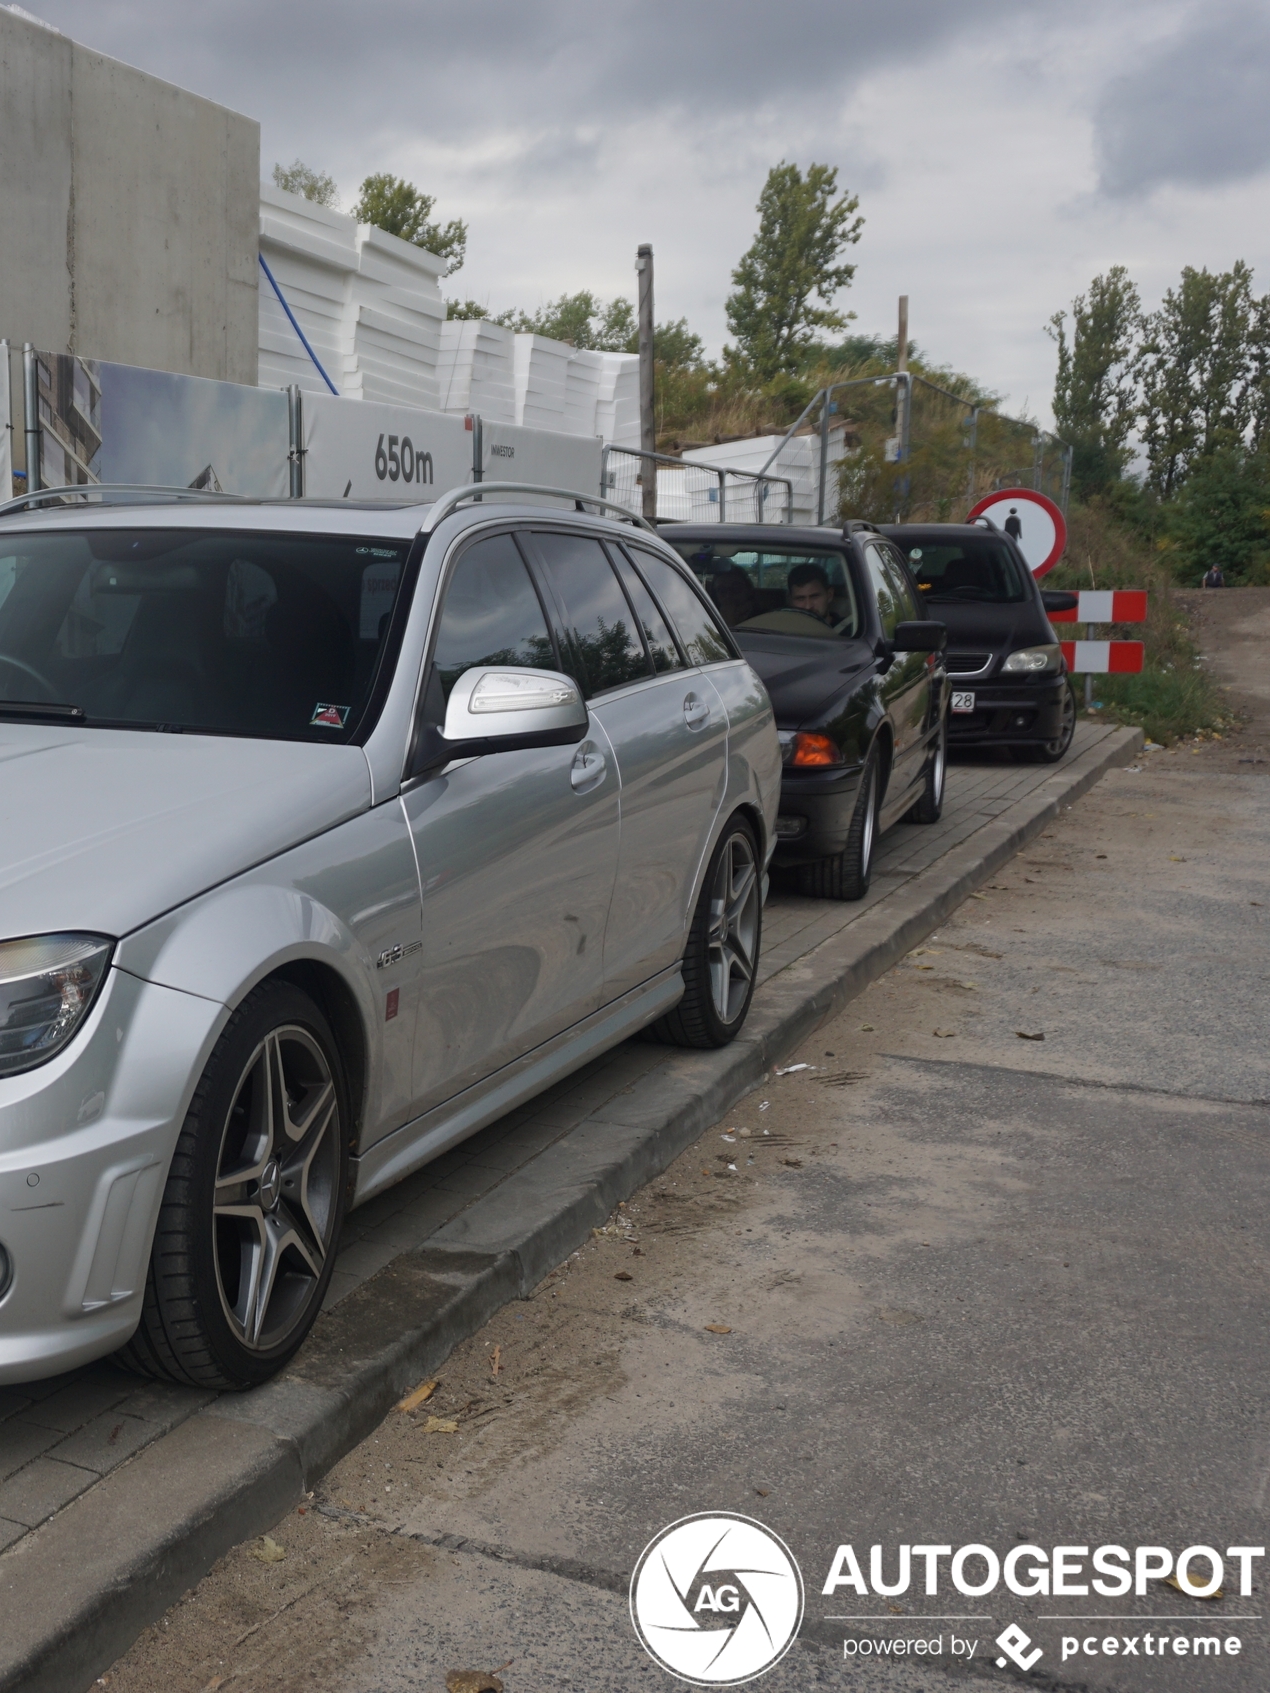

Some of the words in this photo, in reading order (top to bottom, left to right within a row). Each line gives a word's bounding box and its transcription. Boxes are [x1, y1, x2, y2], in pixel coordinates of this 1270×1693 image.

[491, 444, 515, 459] INWESTOR
[375, 434, 433, 485] 650m
[952, 693, 973, 708] 28
